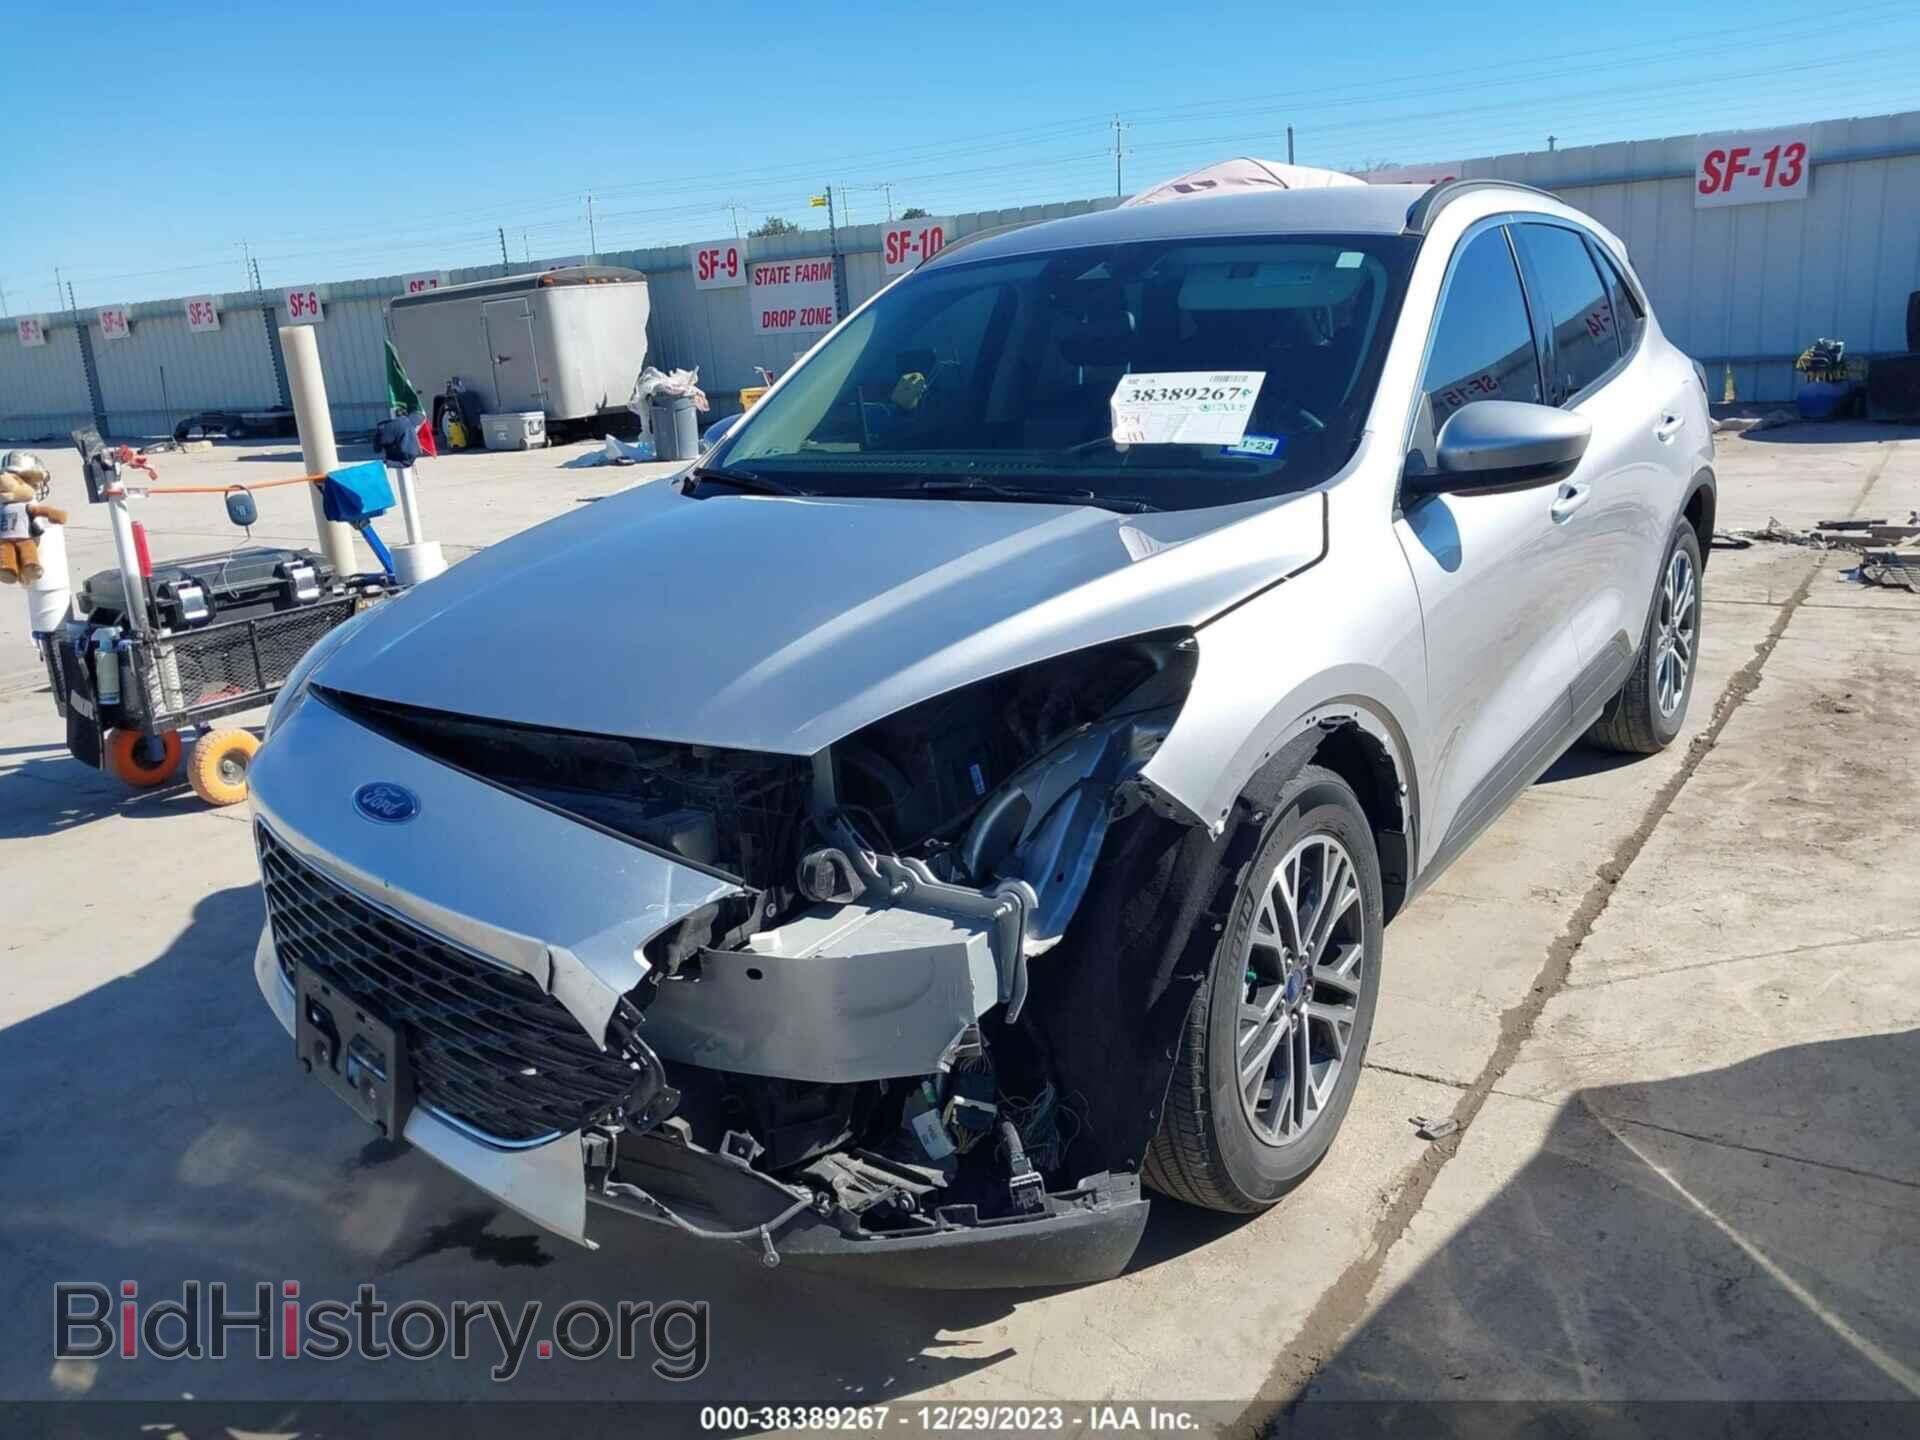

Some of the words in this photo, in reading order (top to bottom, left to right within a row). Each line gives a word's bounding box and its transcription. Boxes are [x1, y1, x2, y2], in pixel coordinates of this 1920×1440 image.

[1698, 142, 1806, 194] SF-13
[885, 226, 944, 265] SF-10
[698, 247, 738, 280] SF-9
[754, 266, 790, 286] STATE
[794, 261, 832, 283] FARM
[187, 301, 215, 326] SF-5
[288, 290, 318, 318] SF-6
[102, 309, 125, 333] SF-4
[762, 309, 796, 328] DROP
[800, 307, 832, 327] ZONE
[1126, 387, 1242, 402] 38389267
[362, 786, 406, 815] Ford
